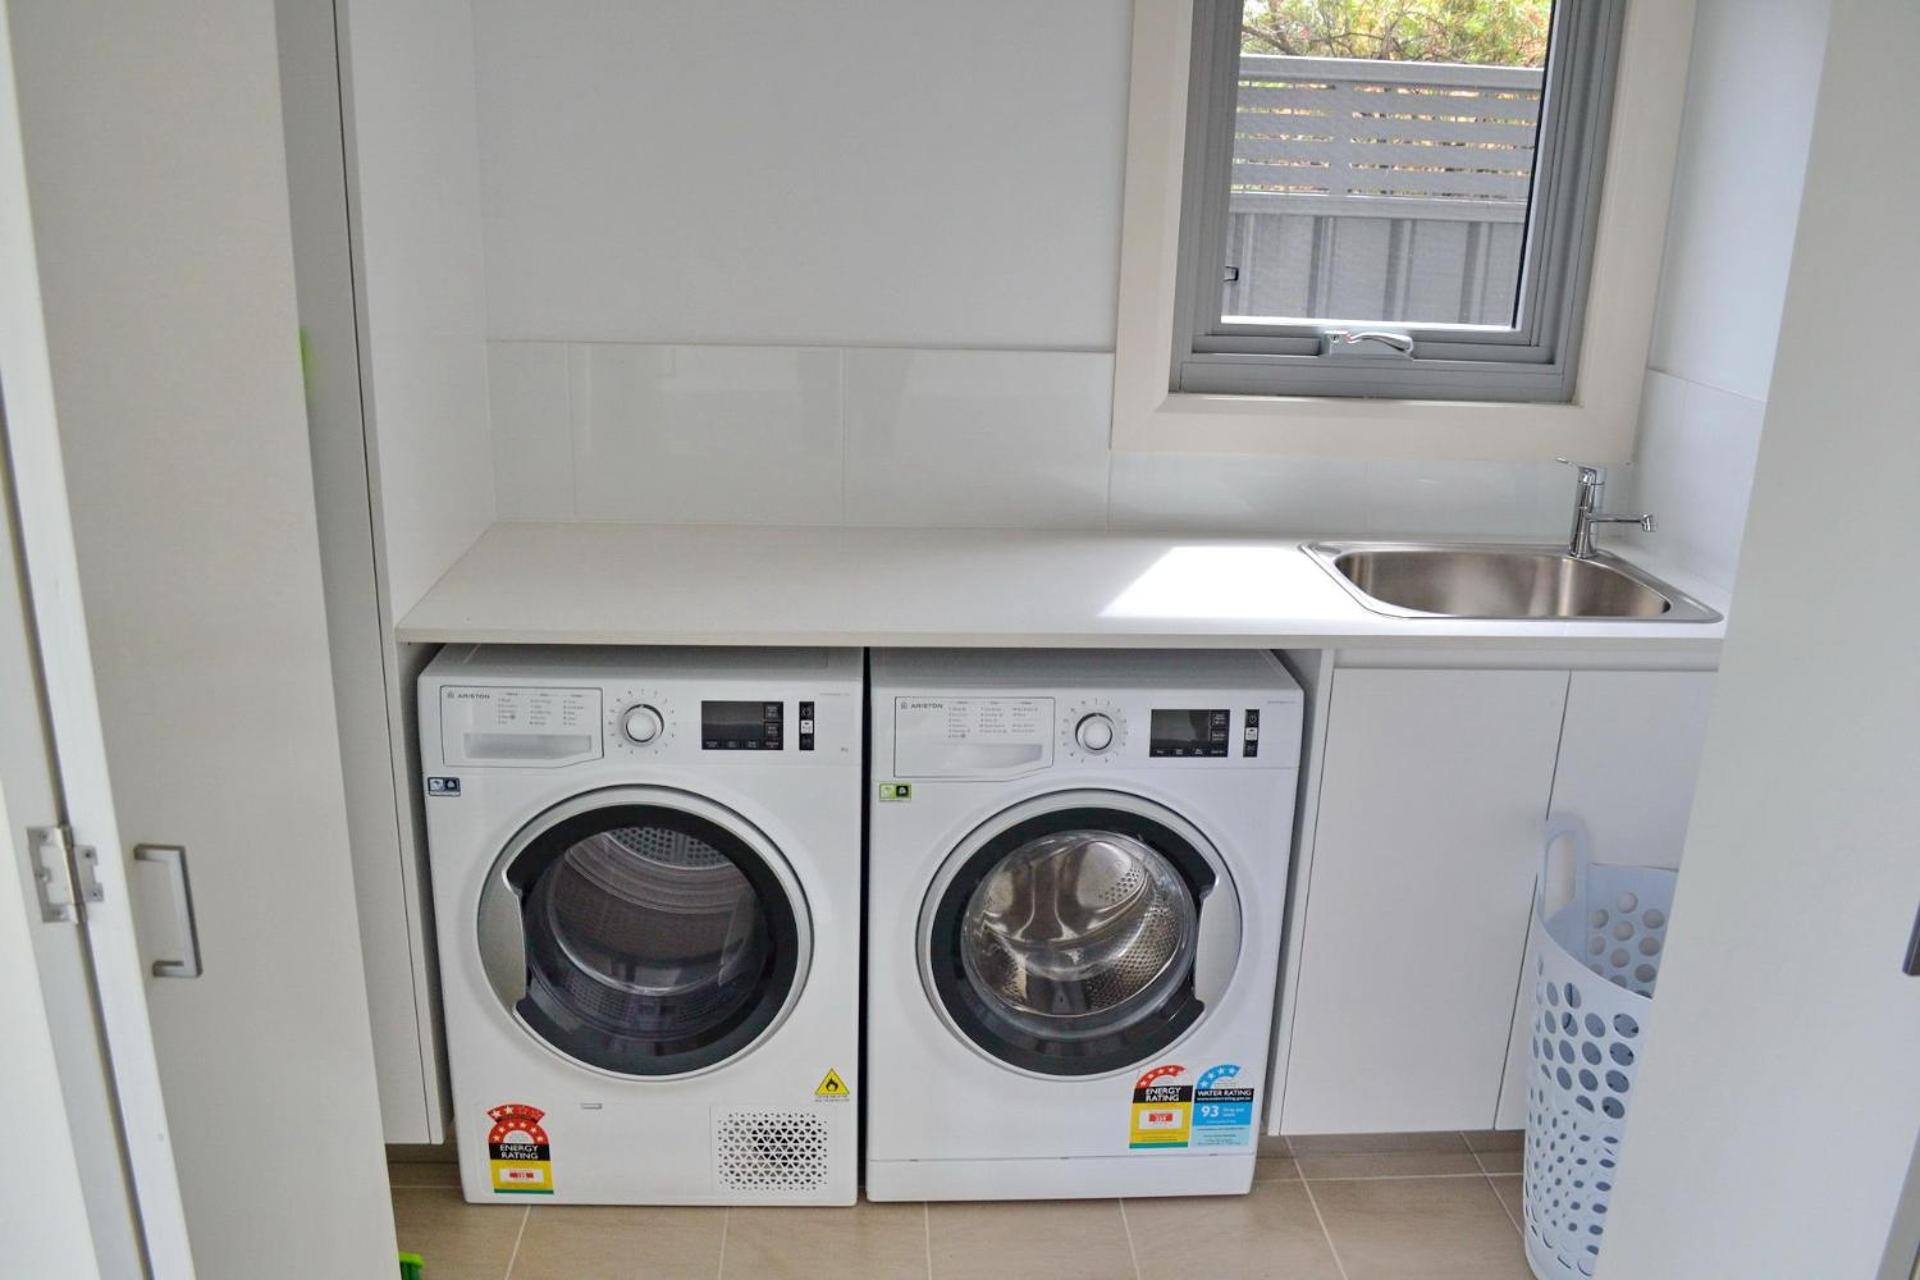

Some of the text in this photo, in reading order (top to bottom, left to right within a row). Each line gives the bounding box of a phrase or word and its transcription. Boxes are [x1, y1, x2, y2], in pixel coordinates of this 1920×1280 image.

[1145, 1094, 1180, 1102] RATING
[1201, 1105, 1219, 1117] 93
[500, 1144, 539, 1152] ENERGY
[501, 1151, 539, 1159] RATING
